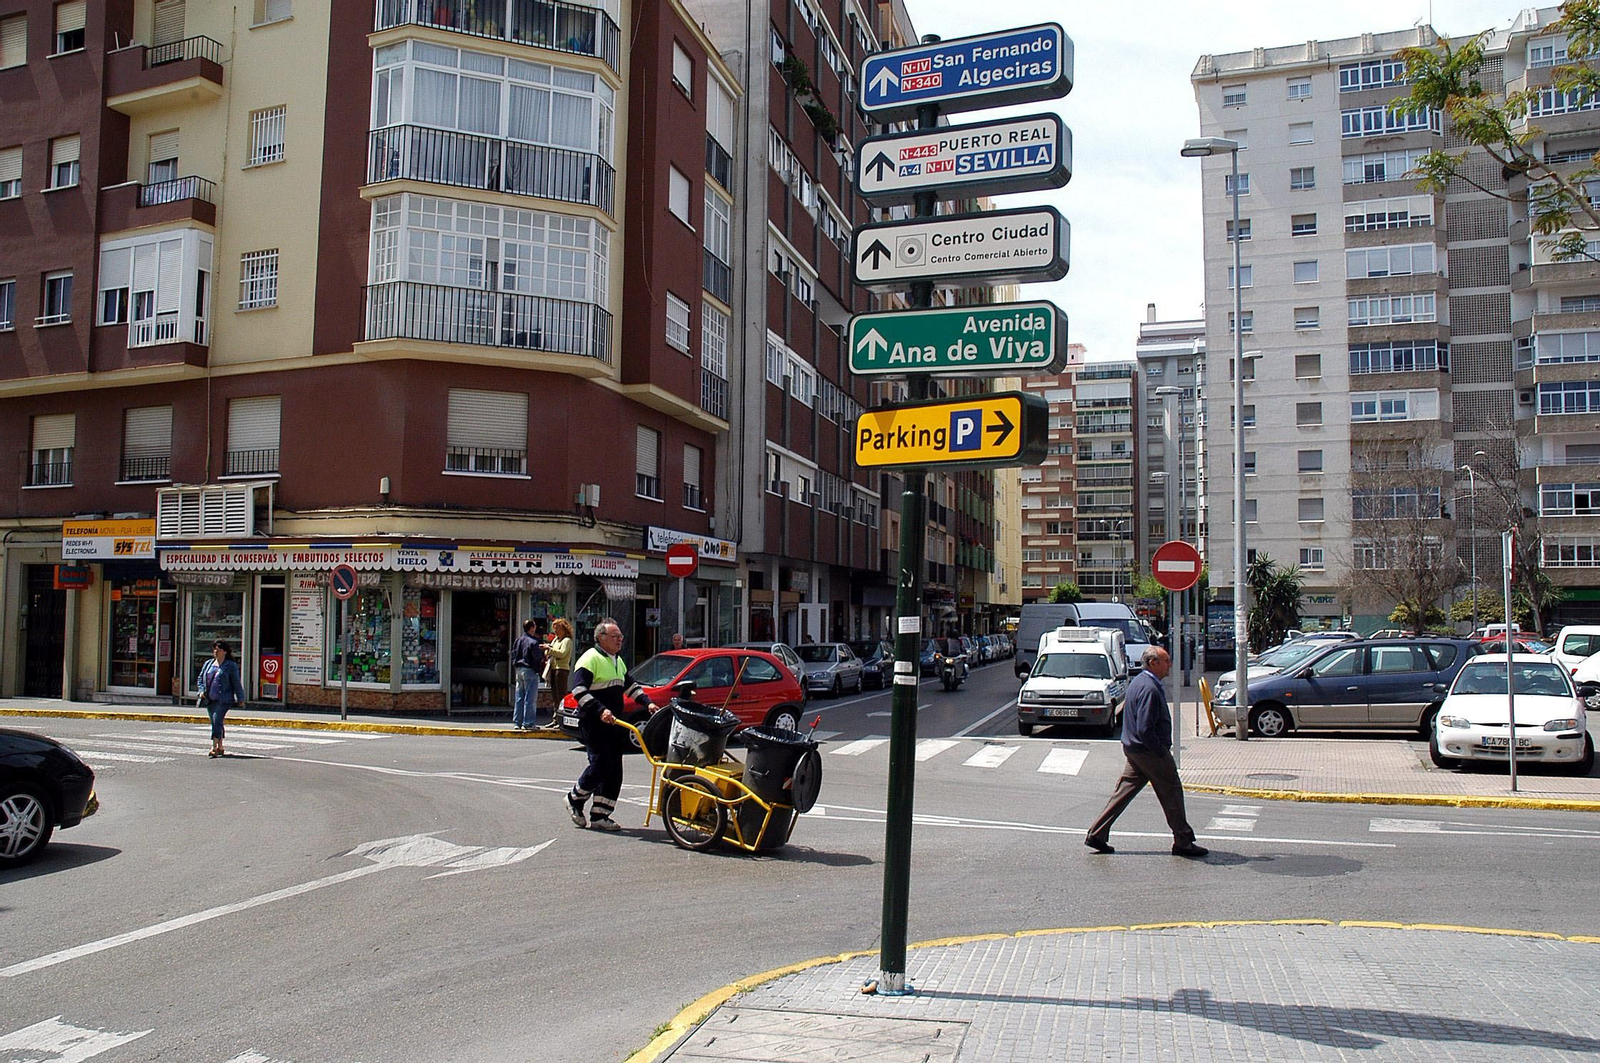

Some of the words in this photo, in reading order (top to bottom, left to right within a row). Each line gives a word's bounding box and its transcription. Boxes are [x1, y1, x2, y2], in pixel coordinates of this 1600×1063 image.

[933, 53, 964, 68] San
[973, 37, 1053, 63] Fernando
[903, 61, 929, 74] N-IV
[958, 60, 1052, 87] Algeciras
[902, 75, 940, 90] N-340
[939, 133, 1002, 152] PUERTO
[1009, 127, 1051, 143] REAL
[901, 146, 937, 159] N-443
[958, 146, 1050, 173] SEVILLA
[900, 165, 920, 176] A-4
[926, 160, 953, 173] N-IV
[932, 231, 985, 247] Centro
[992, 223, 1049, 241] Ciudad
[930, 254, 961, 264] Centro
[964, 250, 1010, 261] Comercial
[1013, 247, 1048, 258] Abierto
[963, 313, 1046, 333] Avenida
[888, 342, 937, 364] Ana
[947, 339, 978, 361] de
[988, 336, 1045, 363] Viya
[860, 425, 947, 451] Parking
[956, 417, 975, 445] P
[66, 525, 99, 535] TELEFONÍA
[166, 554, 217, 564] ESPECIALIDAD
[220, 554, 231, 563] EN
[233, 553, 278, 563] CONSERVAS
[283, 553, 288, 563] Y
[293, 553, 340, 563] EMBUTIDOS
[344, 552, 384, 563] SELECTOS
[397, 557, 428, 566] HIELO
[470, 551, 543, 559] ALIMENTACION
[470, 560, 543, 568] RHIN
[555, 561, 584, 569] HIELO
[415, 574, 524, 588] ALIMENTACION
